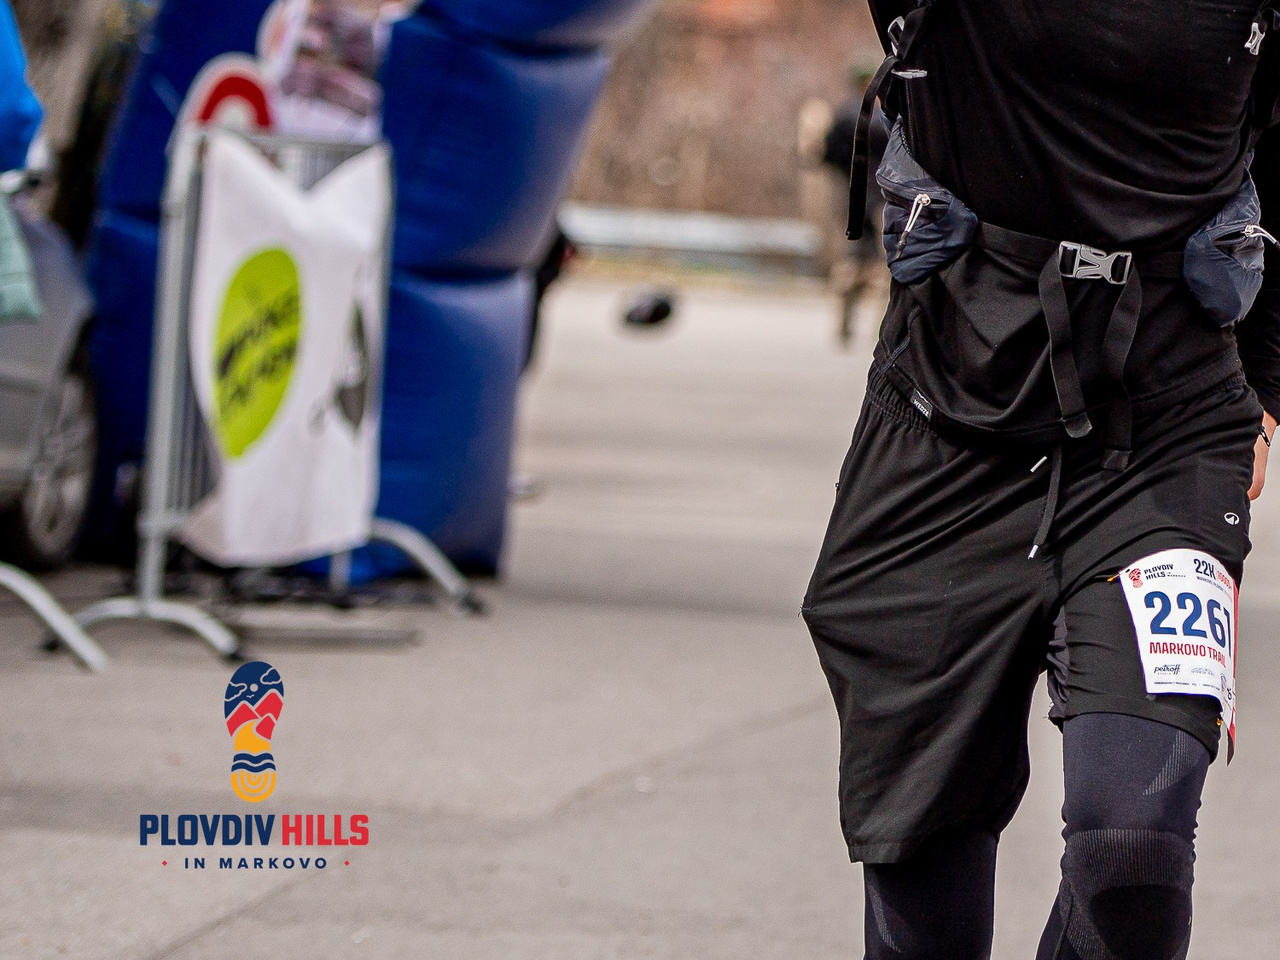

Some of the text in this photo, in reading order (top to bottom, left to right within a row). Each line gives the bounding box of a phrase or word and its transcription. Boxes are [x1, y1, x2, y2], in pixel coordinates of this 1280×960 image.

[1143, 563, 1174, 575] PLOVDIV
[1145, 571, 1166, 581] HILLS
[1149, 642, 1206, 657] MARKOVO
